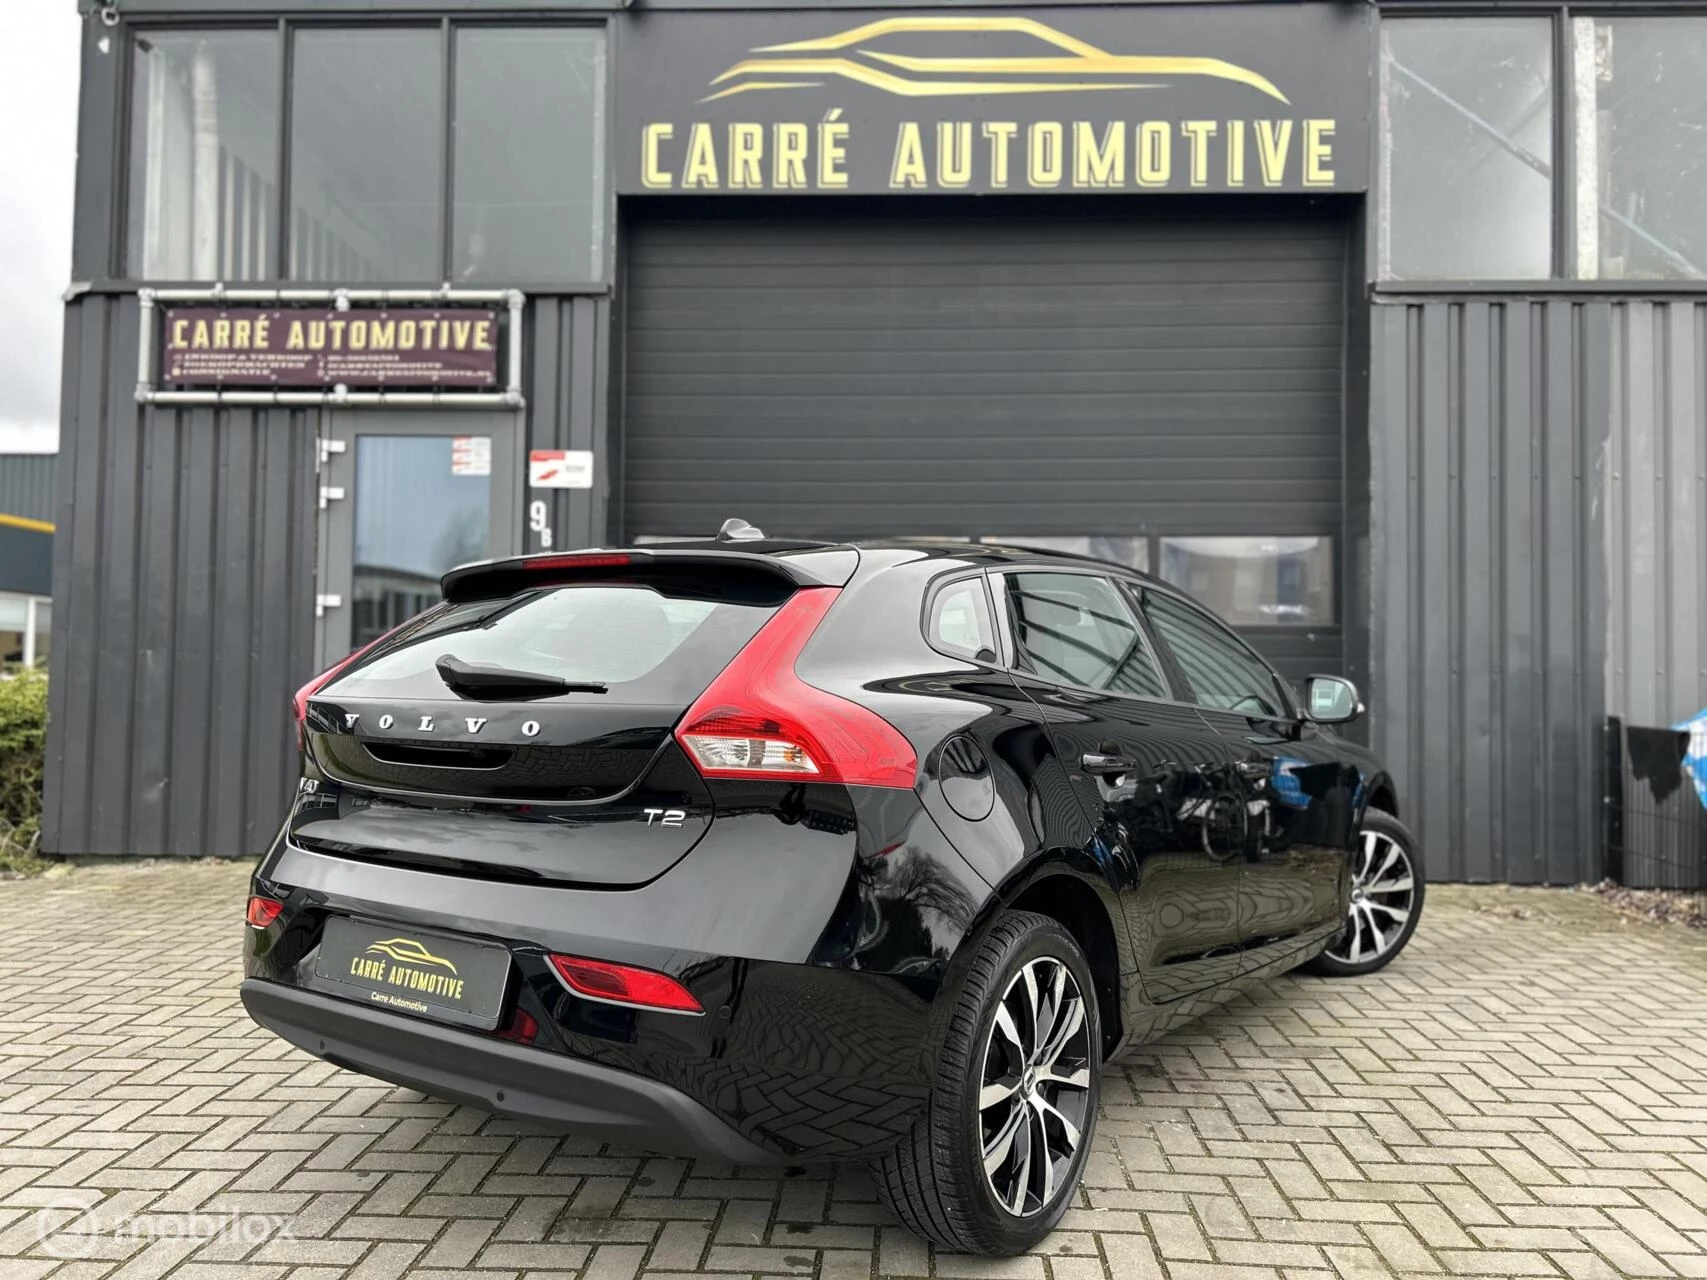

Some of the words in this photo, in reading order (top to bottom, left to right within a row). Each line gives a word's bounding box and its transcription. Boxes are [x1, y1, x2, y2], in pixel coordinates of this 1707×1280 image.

[641, 108, 849, 189] CARRÉ
[889, 119, 1336, 189] AUTOMOTIVE
[172, 314, 271, 350] CARRÉ
[286, 319, 493, 350] AUTOMOTIVE
[530, 500, 547, 532] 9
[344, 713, 541, 737] VOLVO
[643, 808, 687, 829] T2
[350, 957, 386, 982] CARRÉ
[388, 965, 465, 1000] AUTOMOTIVE
[389, 995, 428, 1013] Automotive
